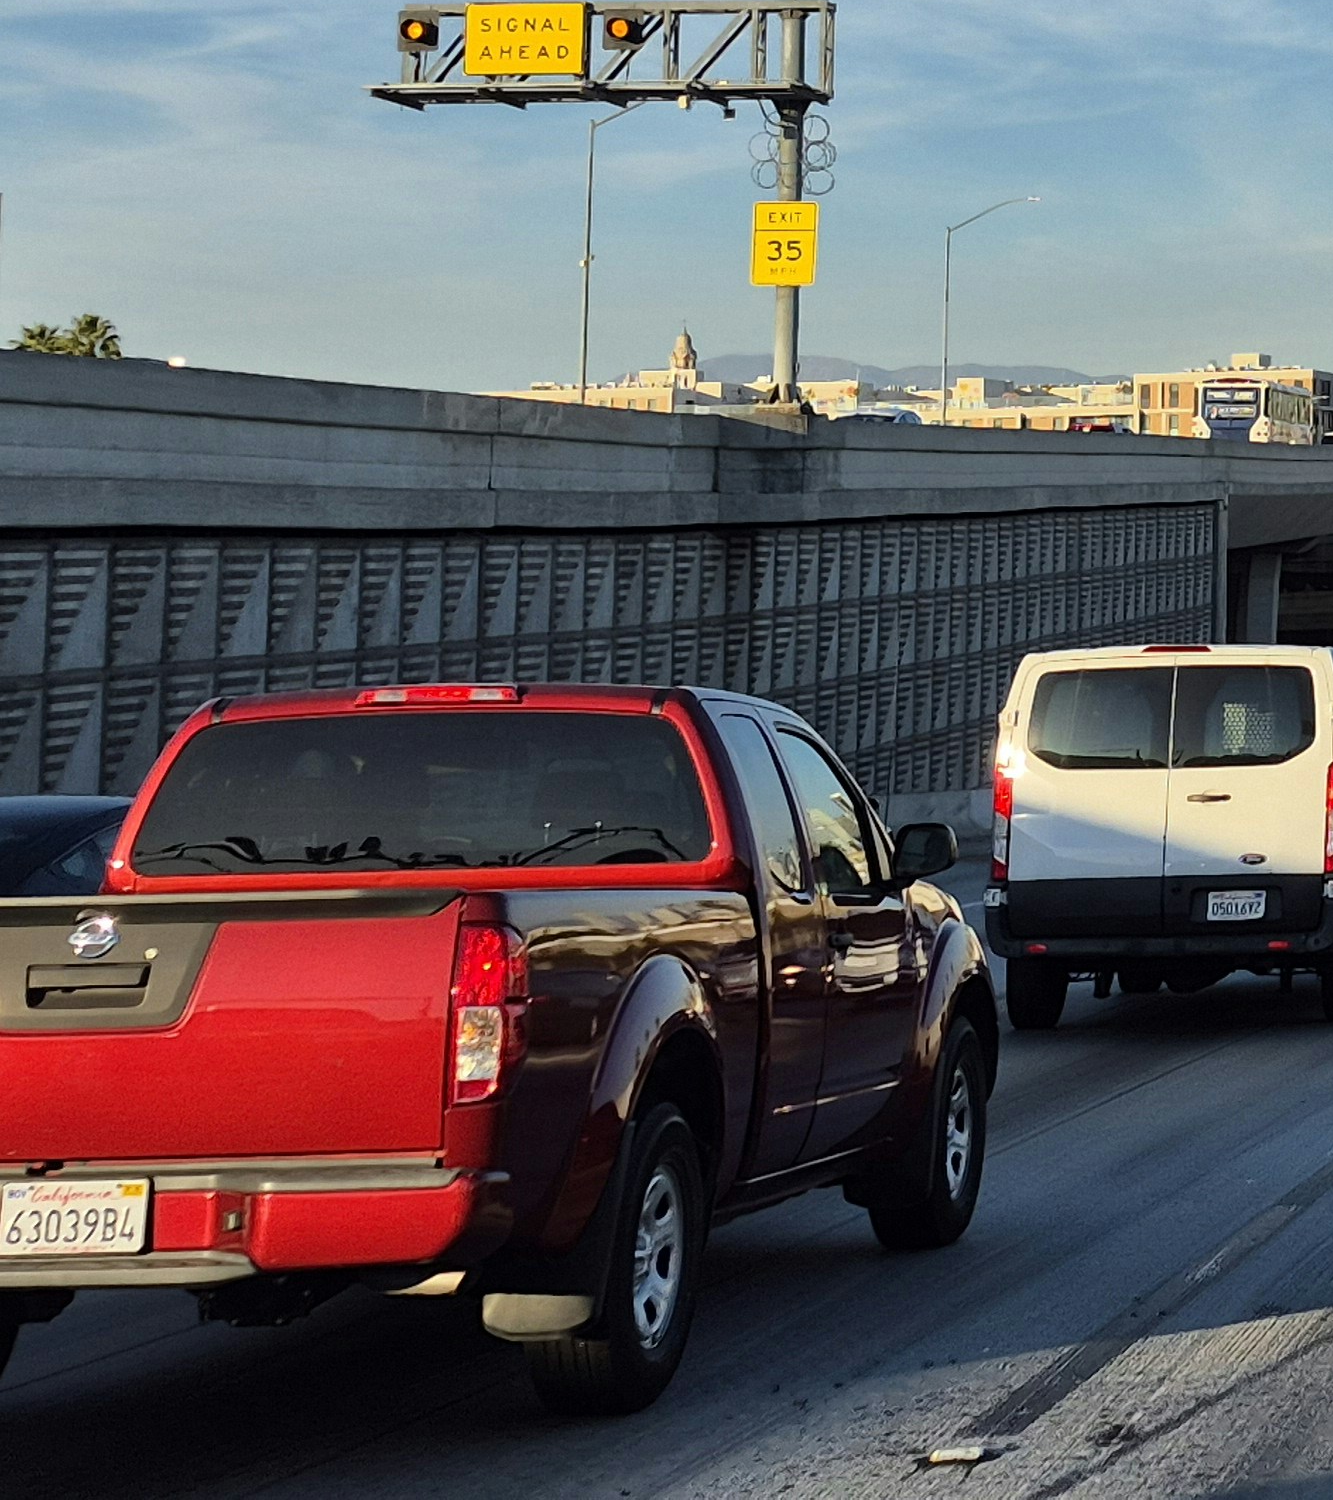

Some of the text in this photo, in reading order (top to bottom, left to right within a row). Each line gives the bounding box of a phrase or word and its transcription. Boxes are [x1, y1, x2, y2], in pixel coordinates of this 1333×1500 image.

[480, 17, 570, 33] SIGNAL
[479, 45, 570, 60] AHEAD
[768, 212, 803, 223] EXIT
[767, 240, 802, 261] 35
[30, 1185, 113, 1207] California
[6, 1207, 135, 1244] 63039B4
